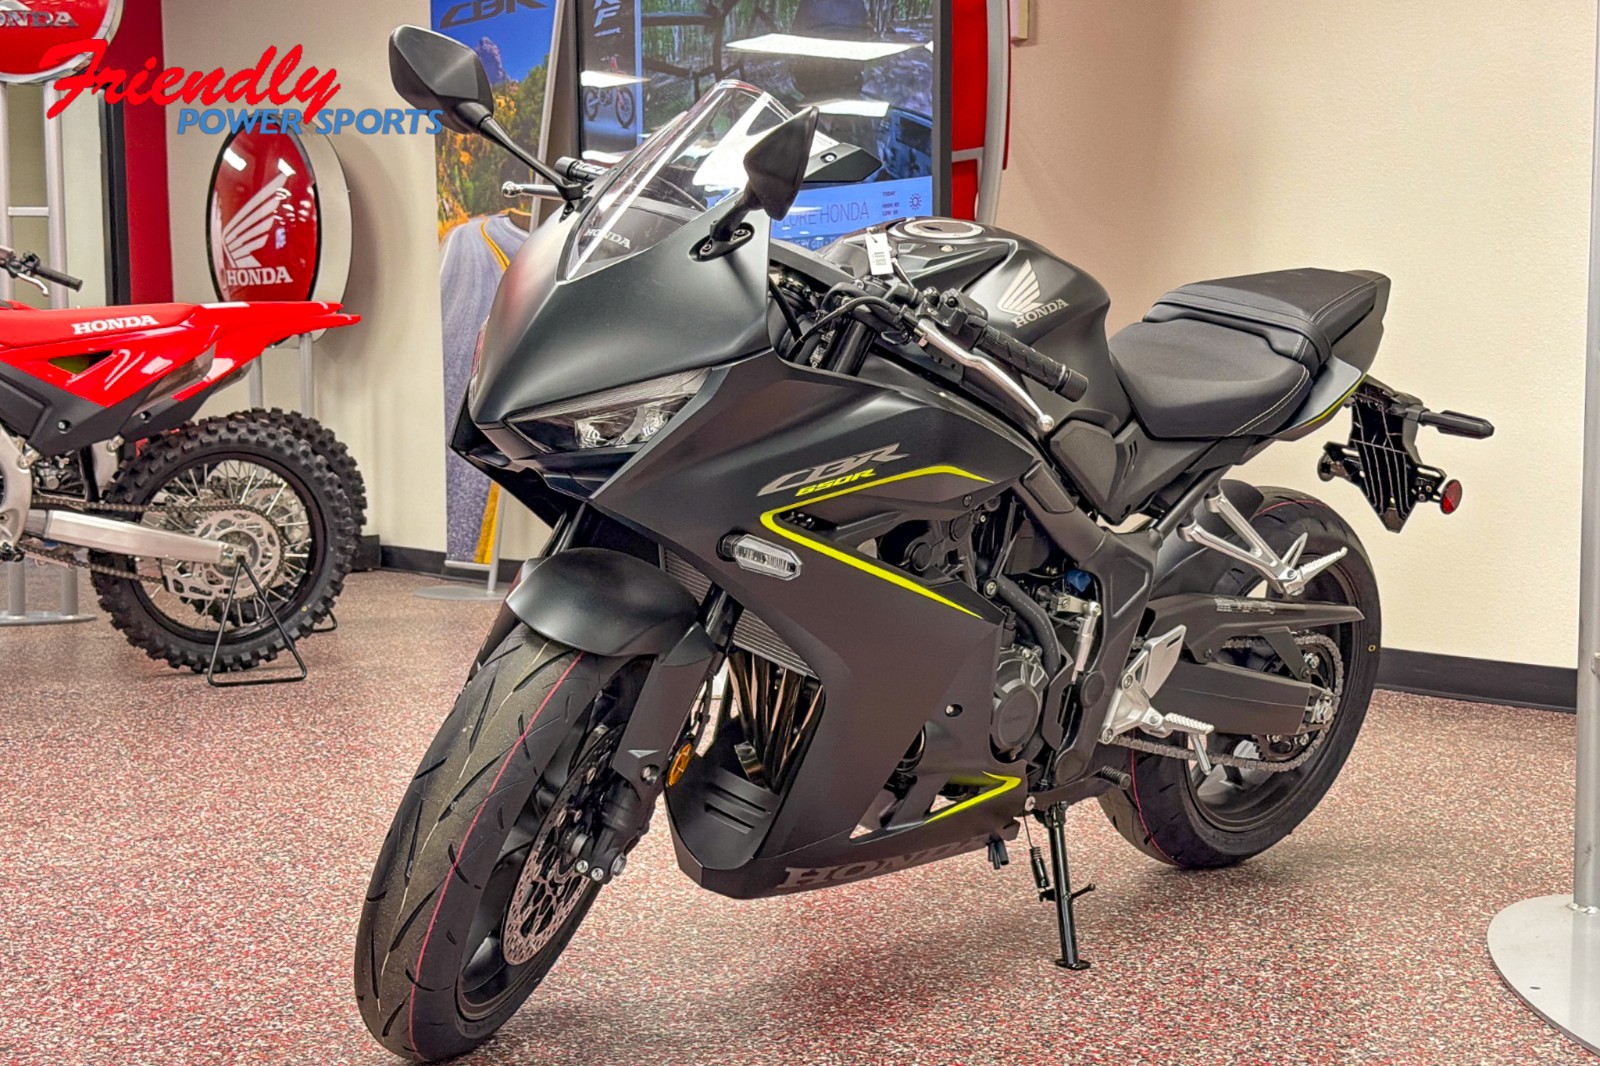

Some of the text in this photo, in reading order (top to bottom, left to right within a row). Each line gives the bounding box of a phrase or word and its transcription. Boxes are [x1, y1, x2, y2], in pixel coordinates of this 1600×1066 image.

[820, 201, 870, 224] HONDA
[226, 266, 293, 287] HONDA
[72, 315, 159, 335] HONDA
[1010, 298, 1069, 329] HONDA
[757, 442, 911, 497] CBR
[795, 468, 877, 497] 650R
